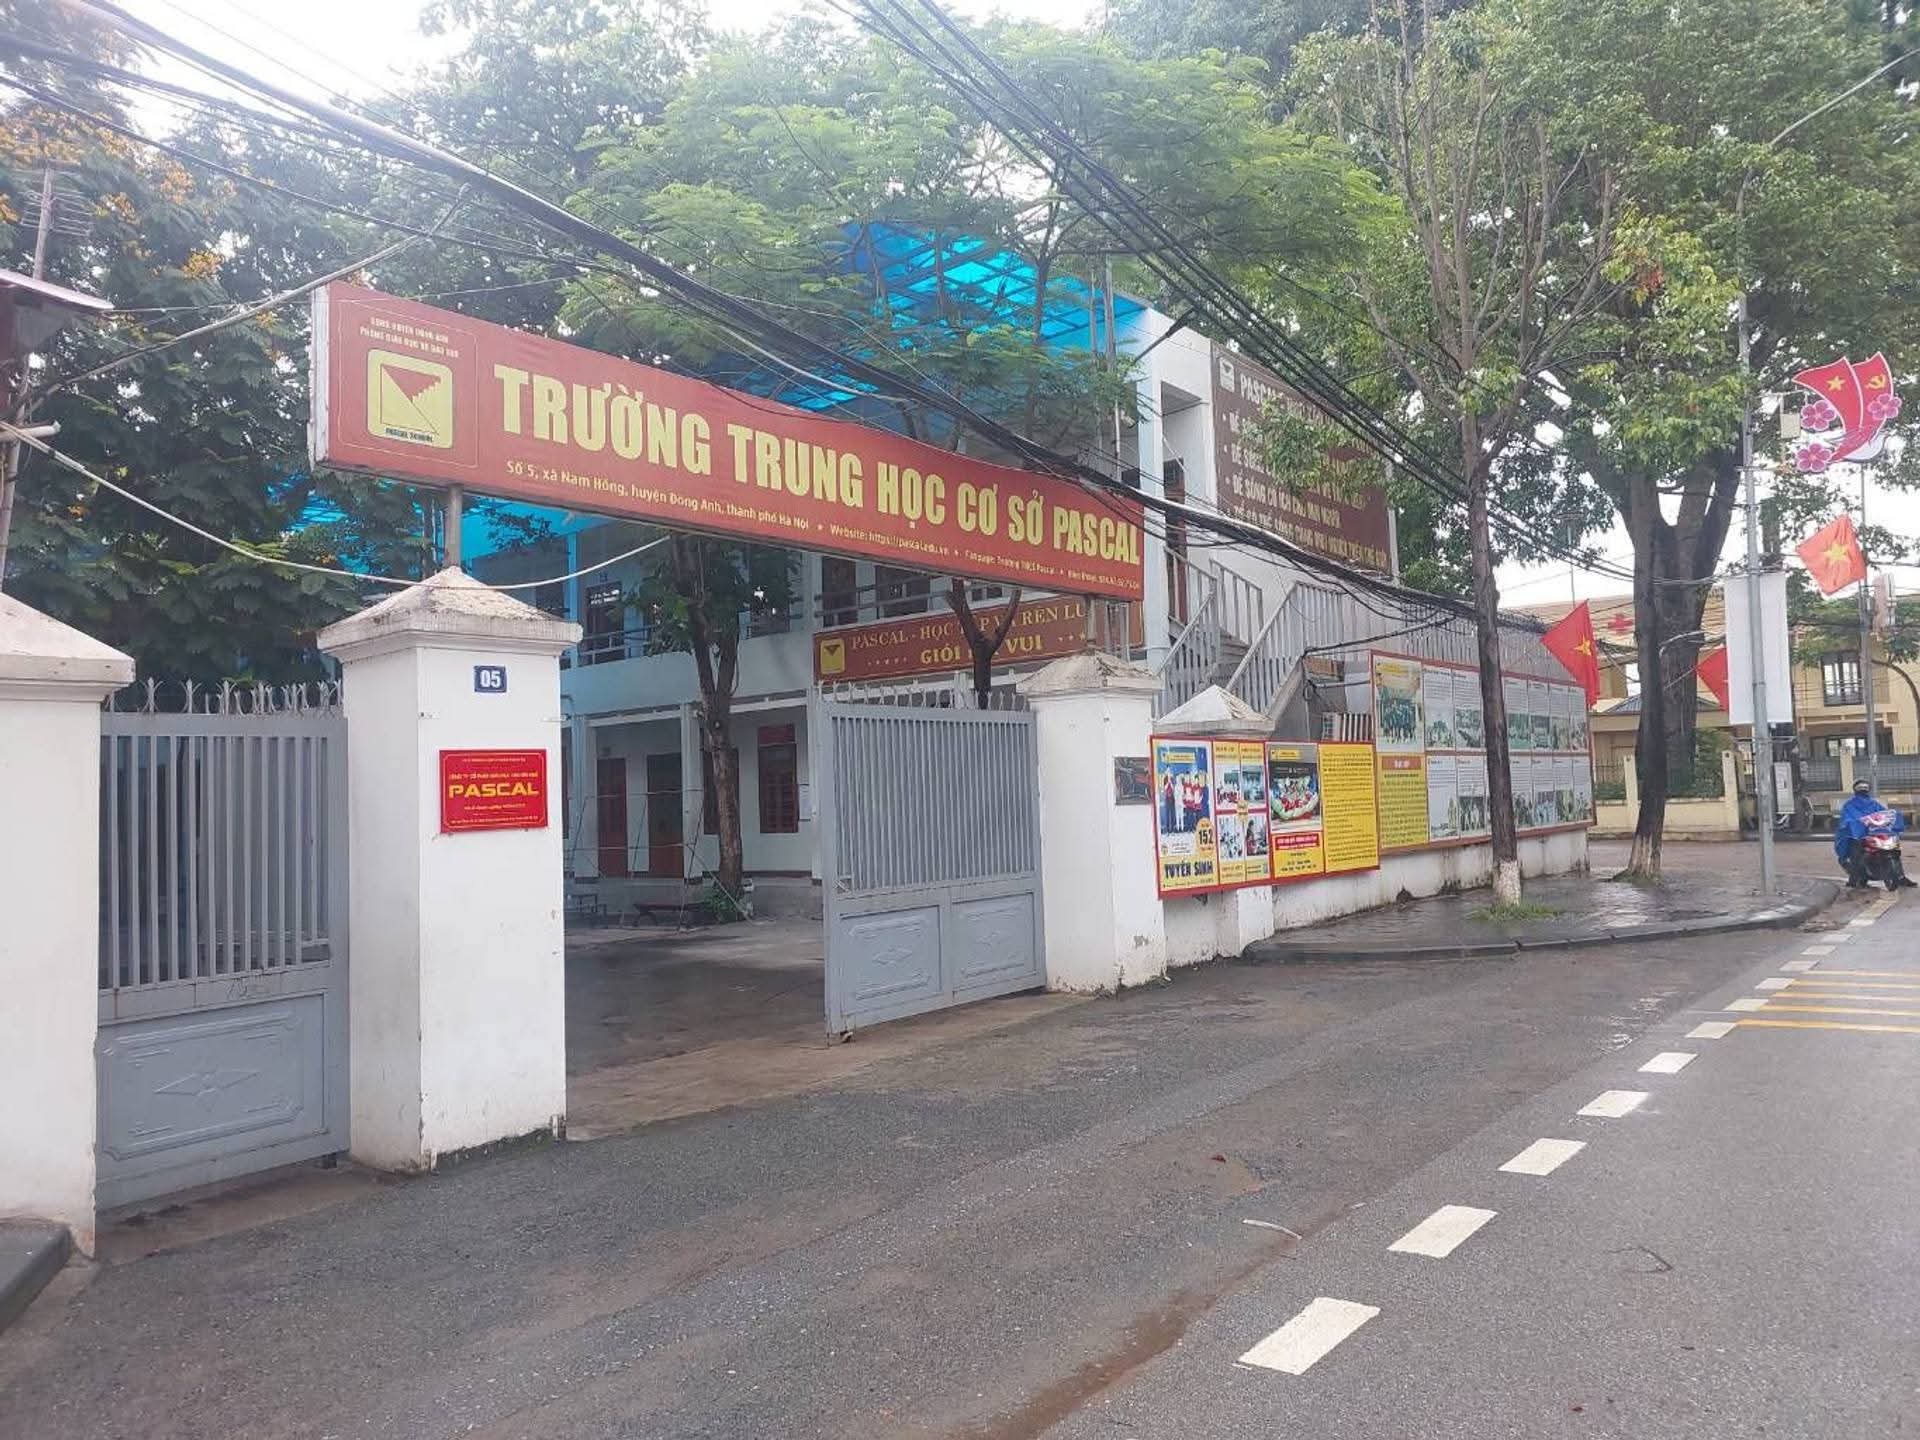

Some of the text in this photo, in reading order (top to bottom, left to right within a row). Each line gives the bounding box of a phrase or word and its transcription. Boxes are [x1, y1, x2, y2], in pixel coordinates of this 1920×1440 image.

[494, 365, 1141, 566] TRƯỜNG TRUNG HỌC CƠ SỞ PASCAL
[506, 460, 523, 475] Số
[561, 471, 590, 488] Nam
[850, 629, 909, 650] PASCAL
[919, 622, 955, 641] HỌC
[1005, 634, 1044, 654] VUI
[480, 669, 501, 688] 05
[448, 781, 540, 800] PASCAL
[1198, 827, 1214, 845] 152
